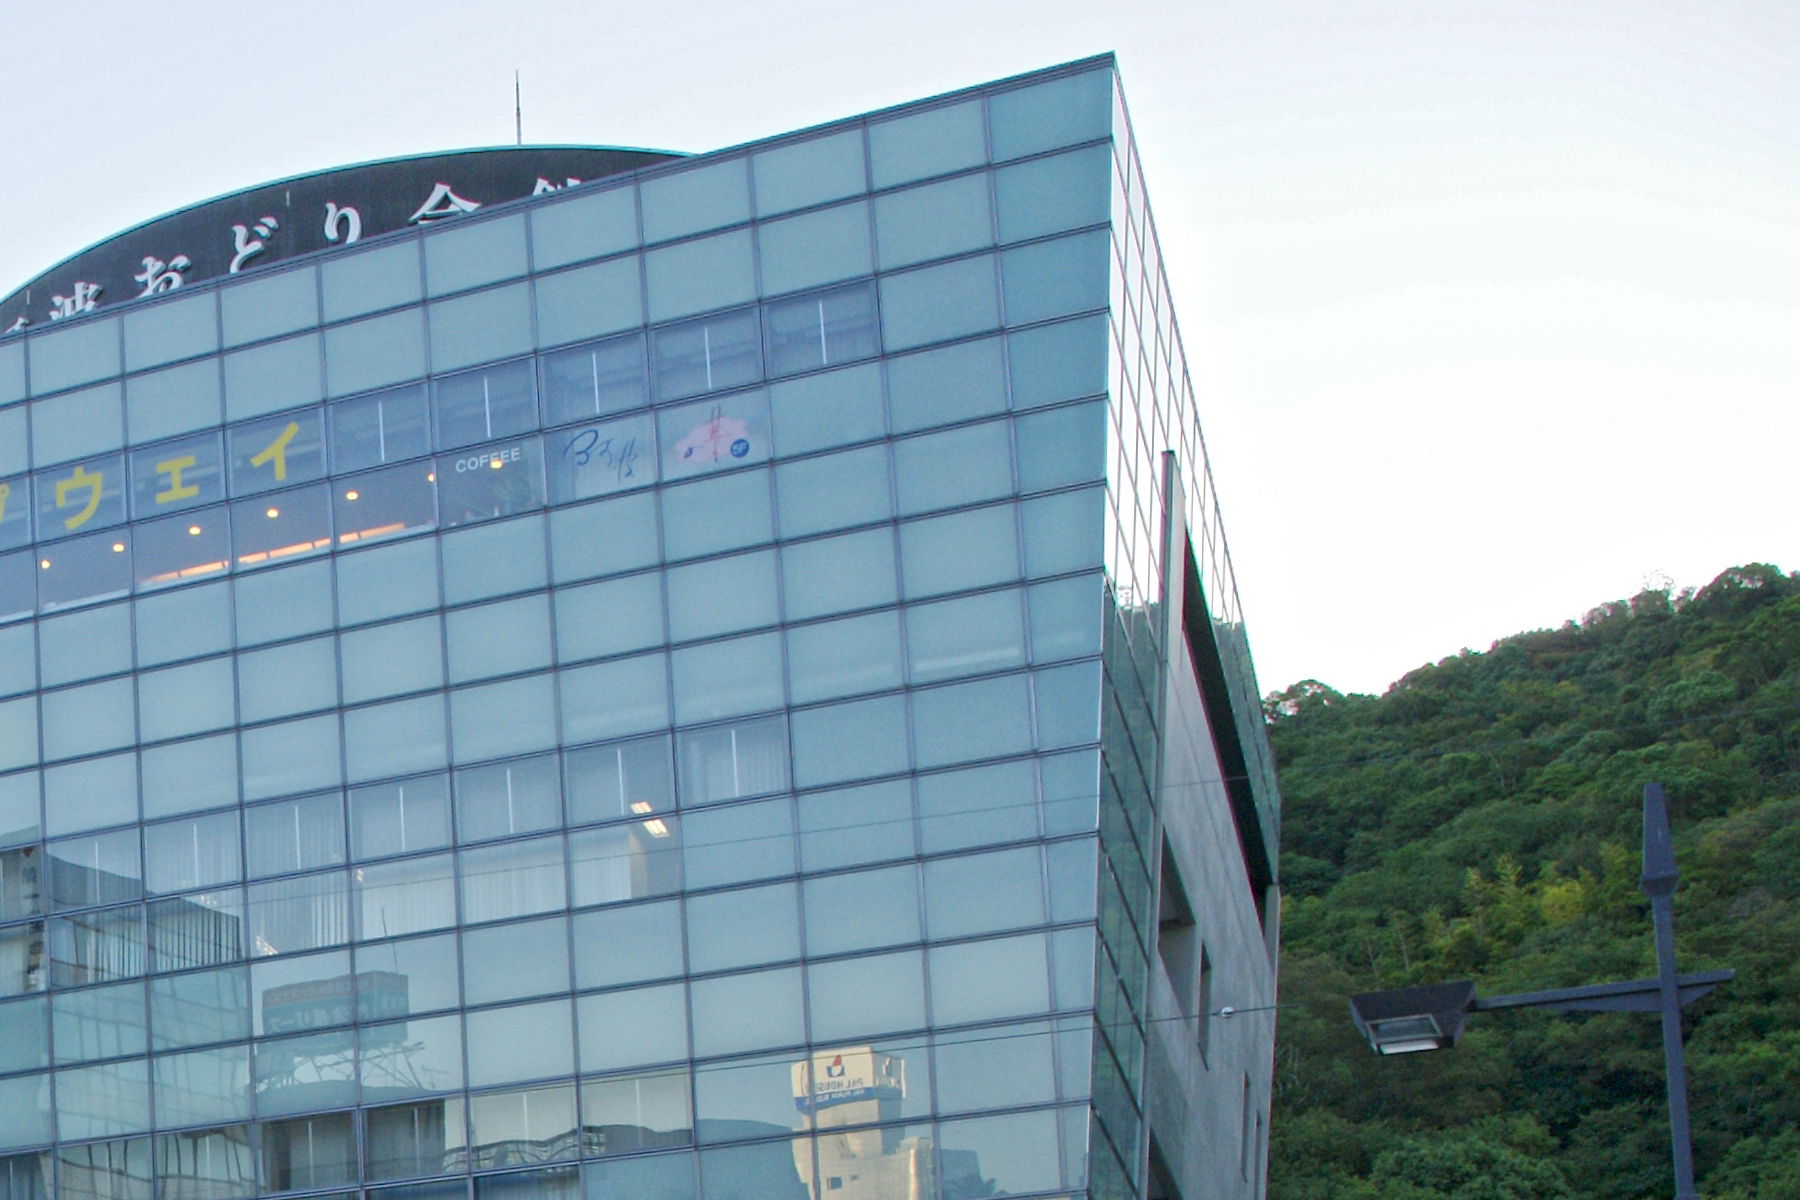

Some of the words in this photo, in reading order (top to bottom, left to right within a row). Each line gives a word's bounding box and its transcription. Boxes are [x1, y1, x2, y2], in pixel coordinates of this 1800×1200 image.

[6, 177, 581, 334] 波おどり会
[456, 447, 521, 473] COFFEE
